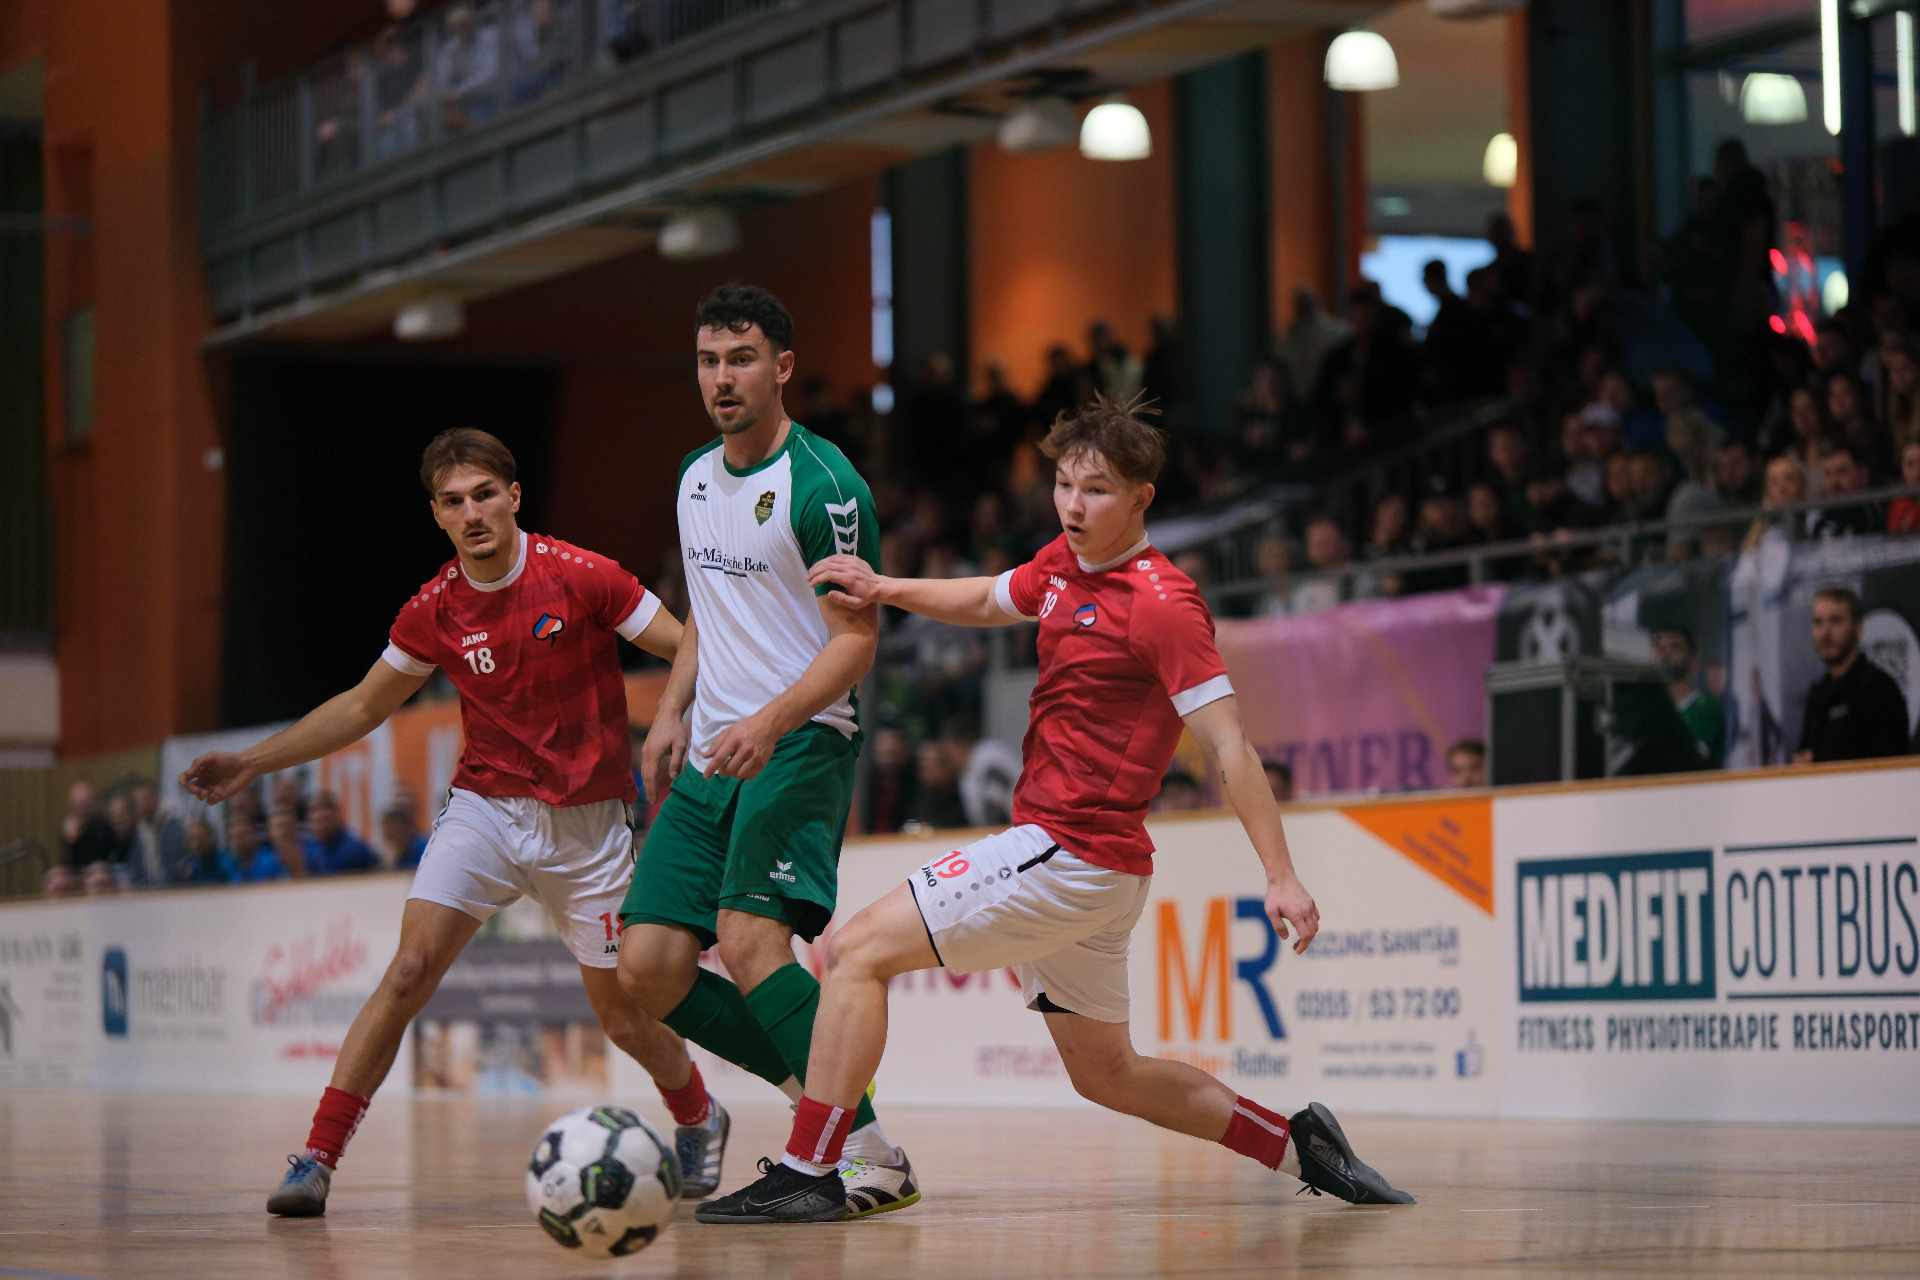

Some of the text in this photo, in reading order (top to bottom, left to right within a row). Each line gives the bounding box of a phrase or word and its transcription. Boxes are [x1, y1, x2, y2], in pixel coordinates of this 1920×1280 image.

[744, 557, 770, 573] Bote
[1049, 574, 1068, 591] JAKO
[1039, 591, 1058, 619] 19
[461, 631, 488, 648] JAKO
[464, 647, 496, 675] 18
[931, 850, 970, 879] 19
[769, 871, 796, 883] erima
[1520, 862, 1920, 990] MEDIFIT COTTBUS
[604, 944, 620, 954] JA
[1517, 1011, 1920, 1051] FITNESS PHYSIOTHERAPIE REHASPORT
